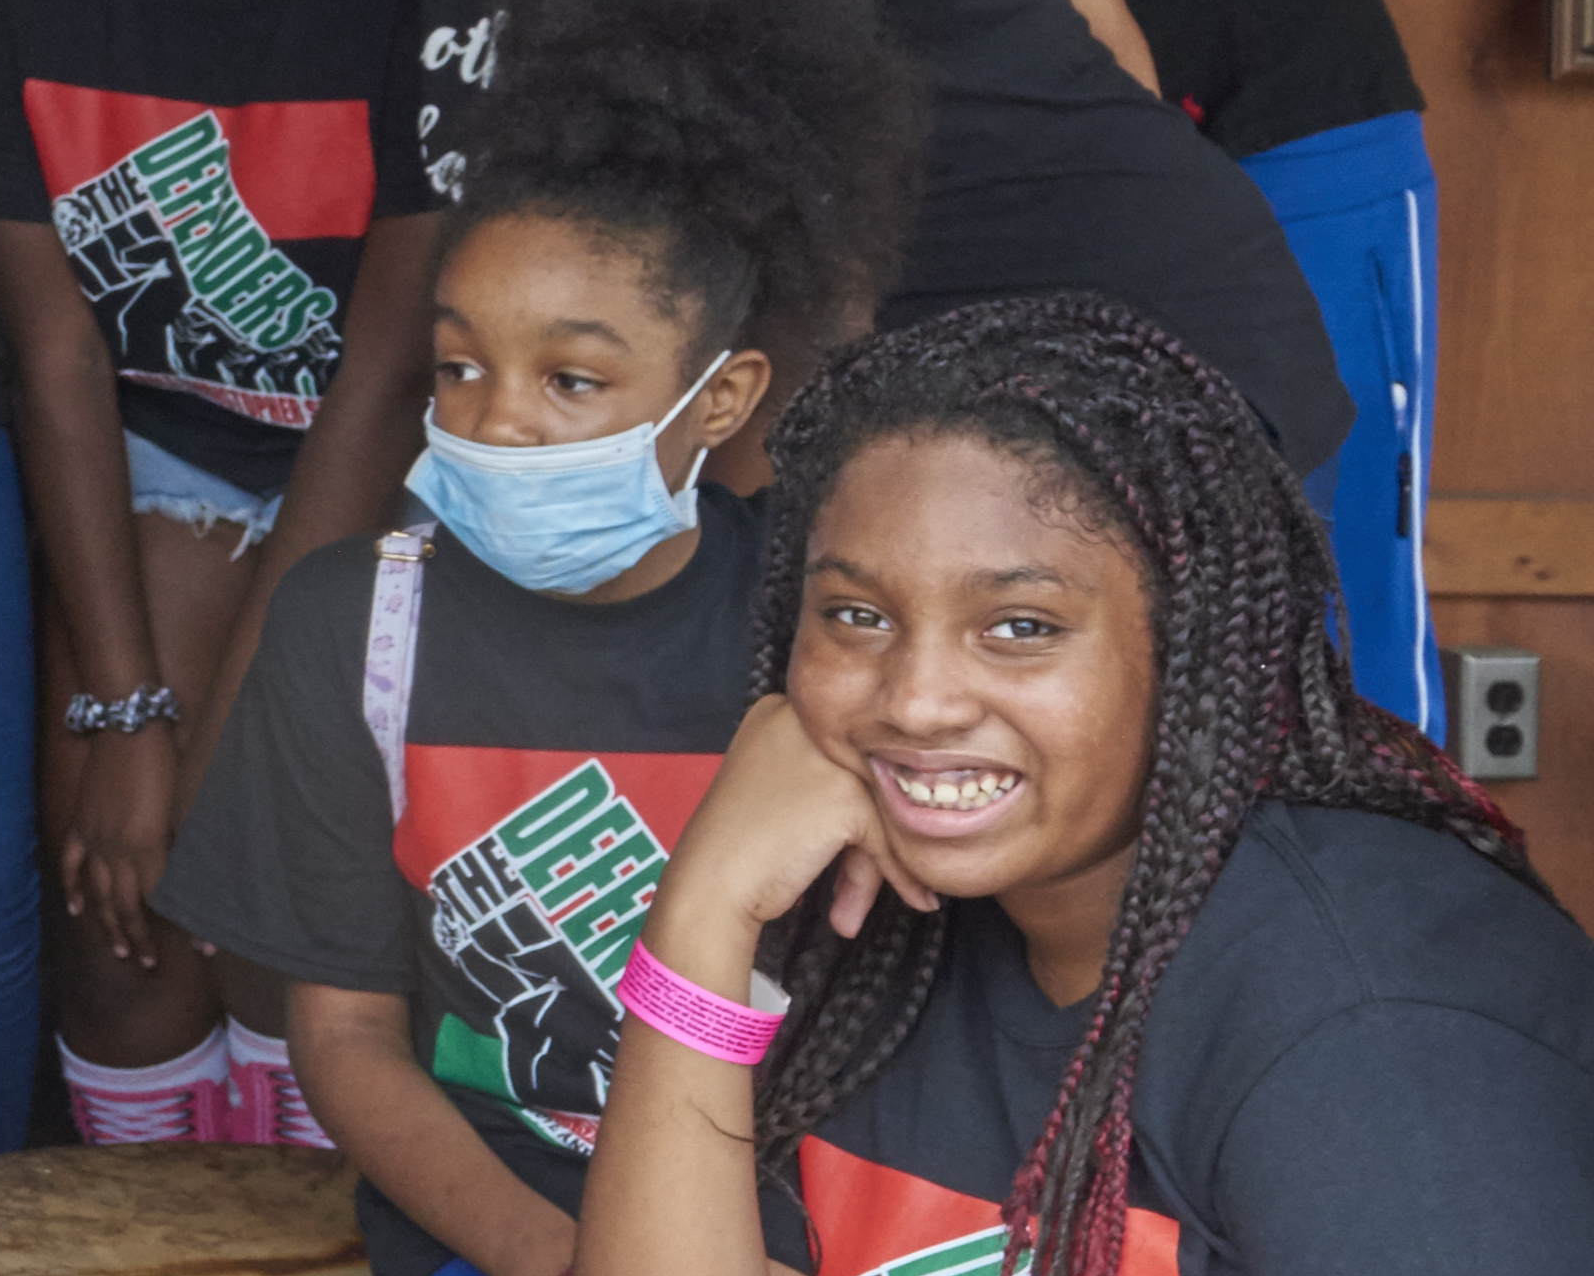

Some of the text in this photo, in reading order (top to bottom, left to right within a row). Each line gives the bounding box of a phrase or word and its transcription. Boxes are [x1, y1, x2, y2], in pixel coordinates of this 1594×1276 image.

[78, 160, 148, 225] THE
[129, 110, 337, 352] DEFENDERS
[432, 832, 524, 923] THE
